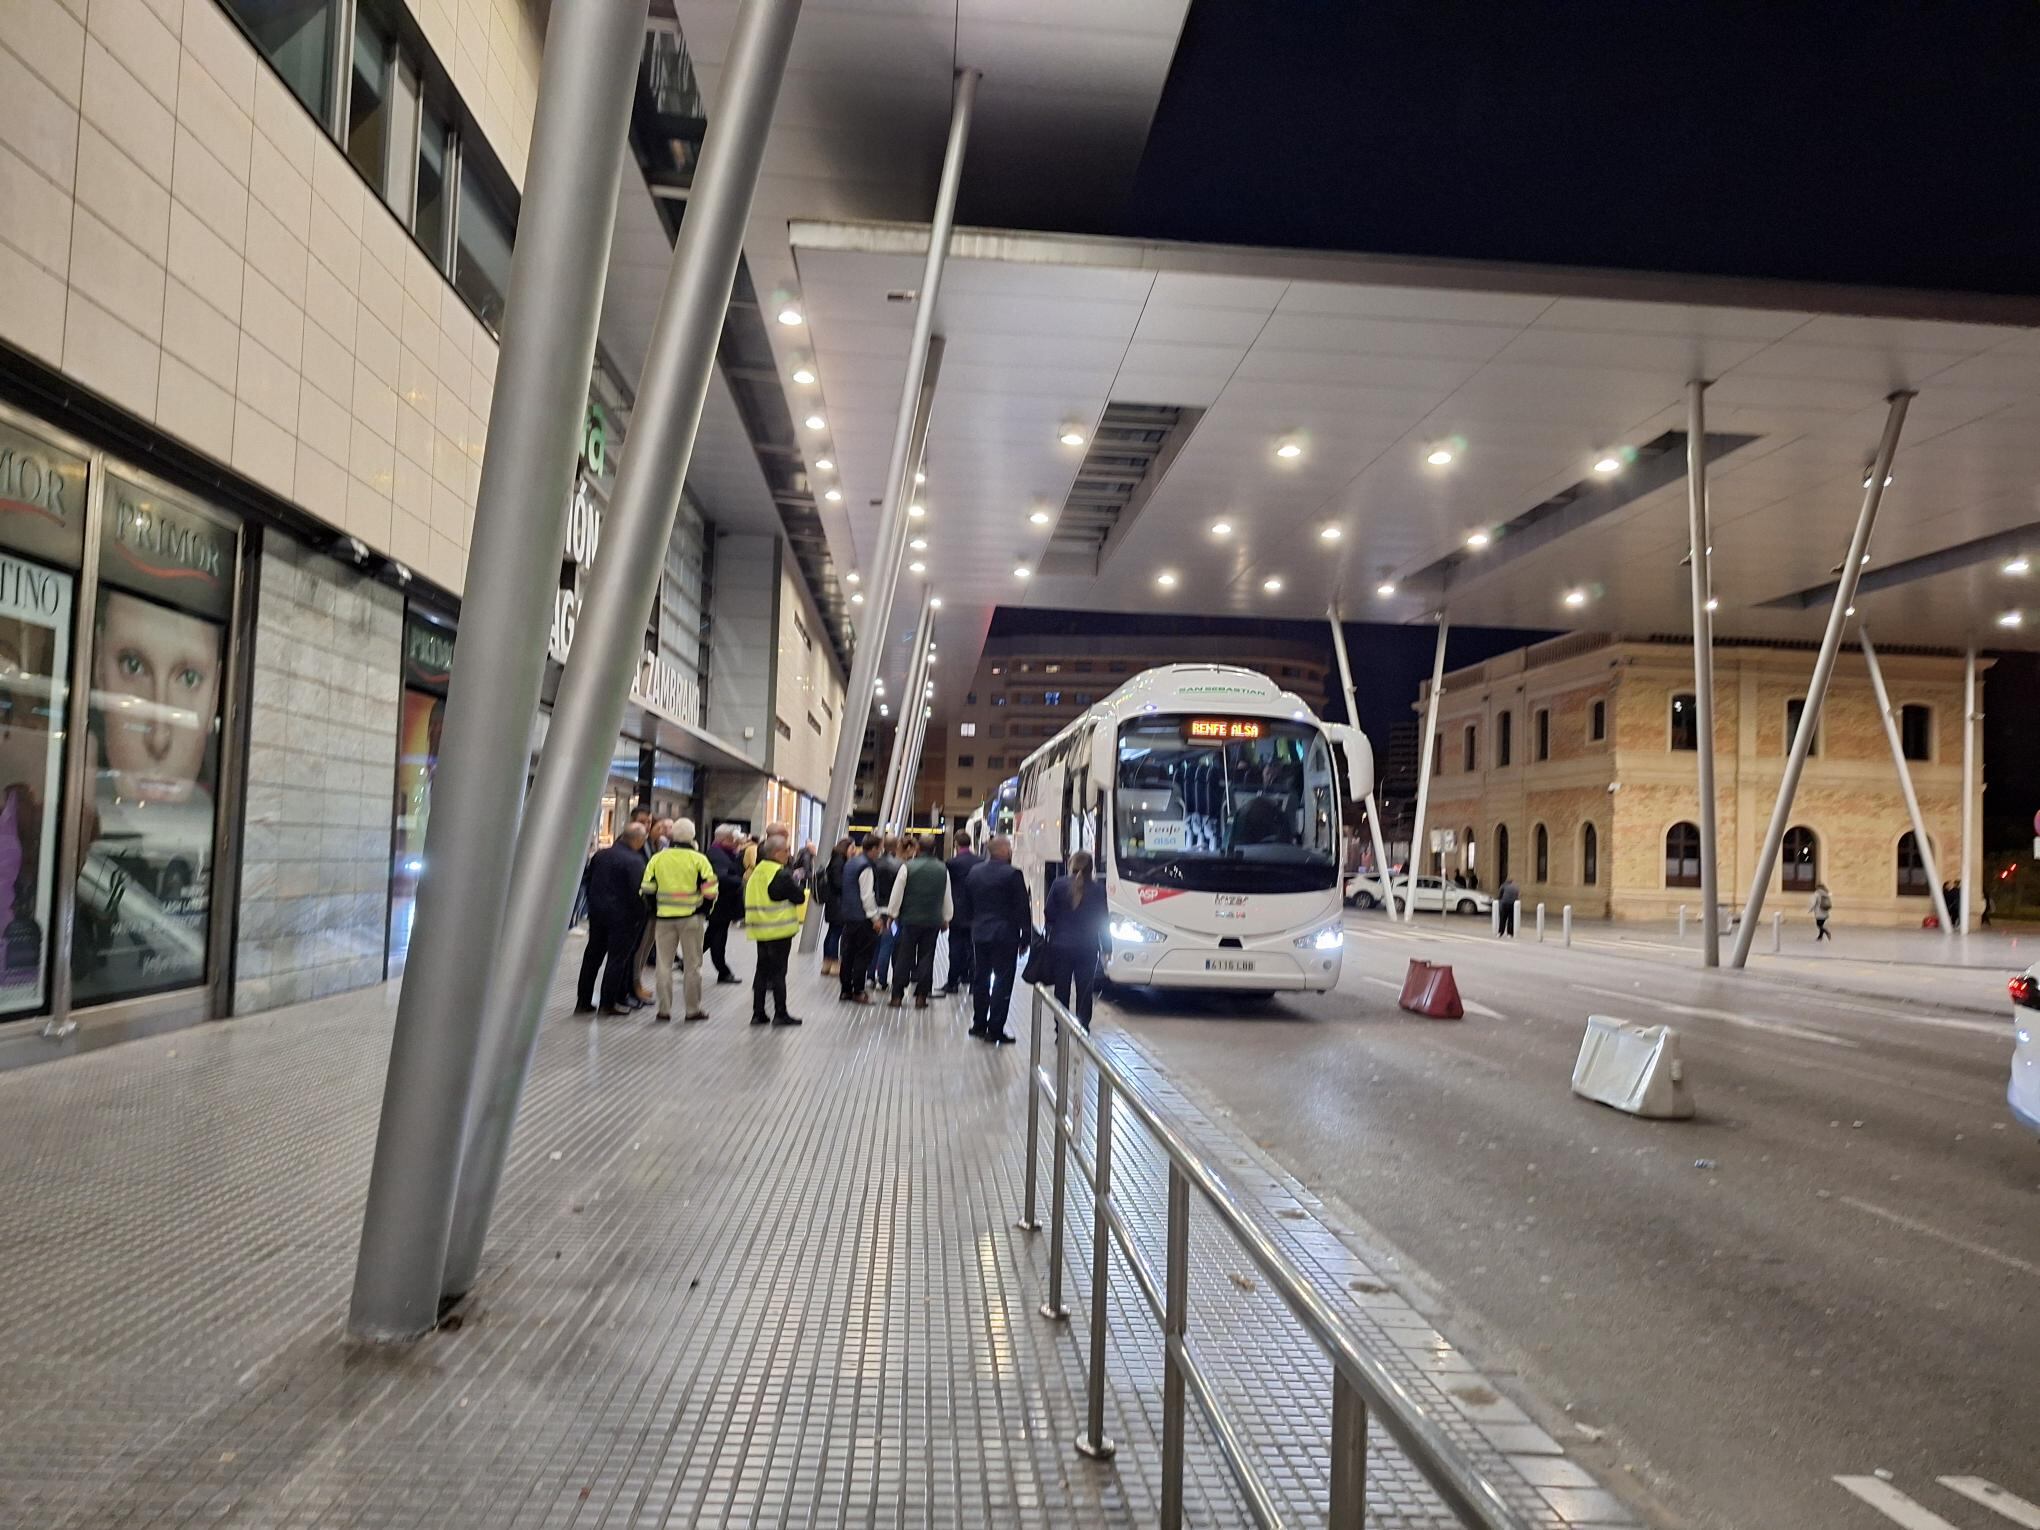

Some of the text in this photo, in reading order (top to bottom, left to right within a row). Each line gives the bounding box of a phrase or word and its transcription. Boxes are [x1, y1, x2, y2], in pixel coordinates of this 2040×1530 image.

[115, 497, 220, 578] PRIMOR
[646, 649, 701, 727] ZAMBRANO
[1191, 720, 1260, 739] RENFE ALSA
